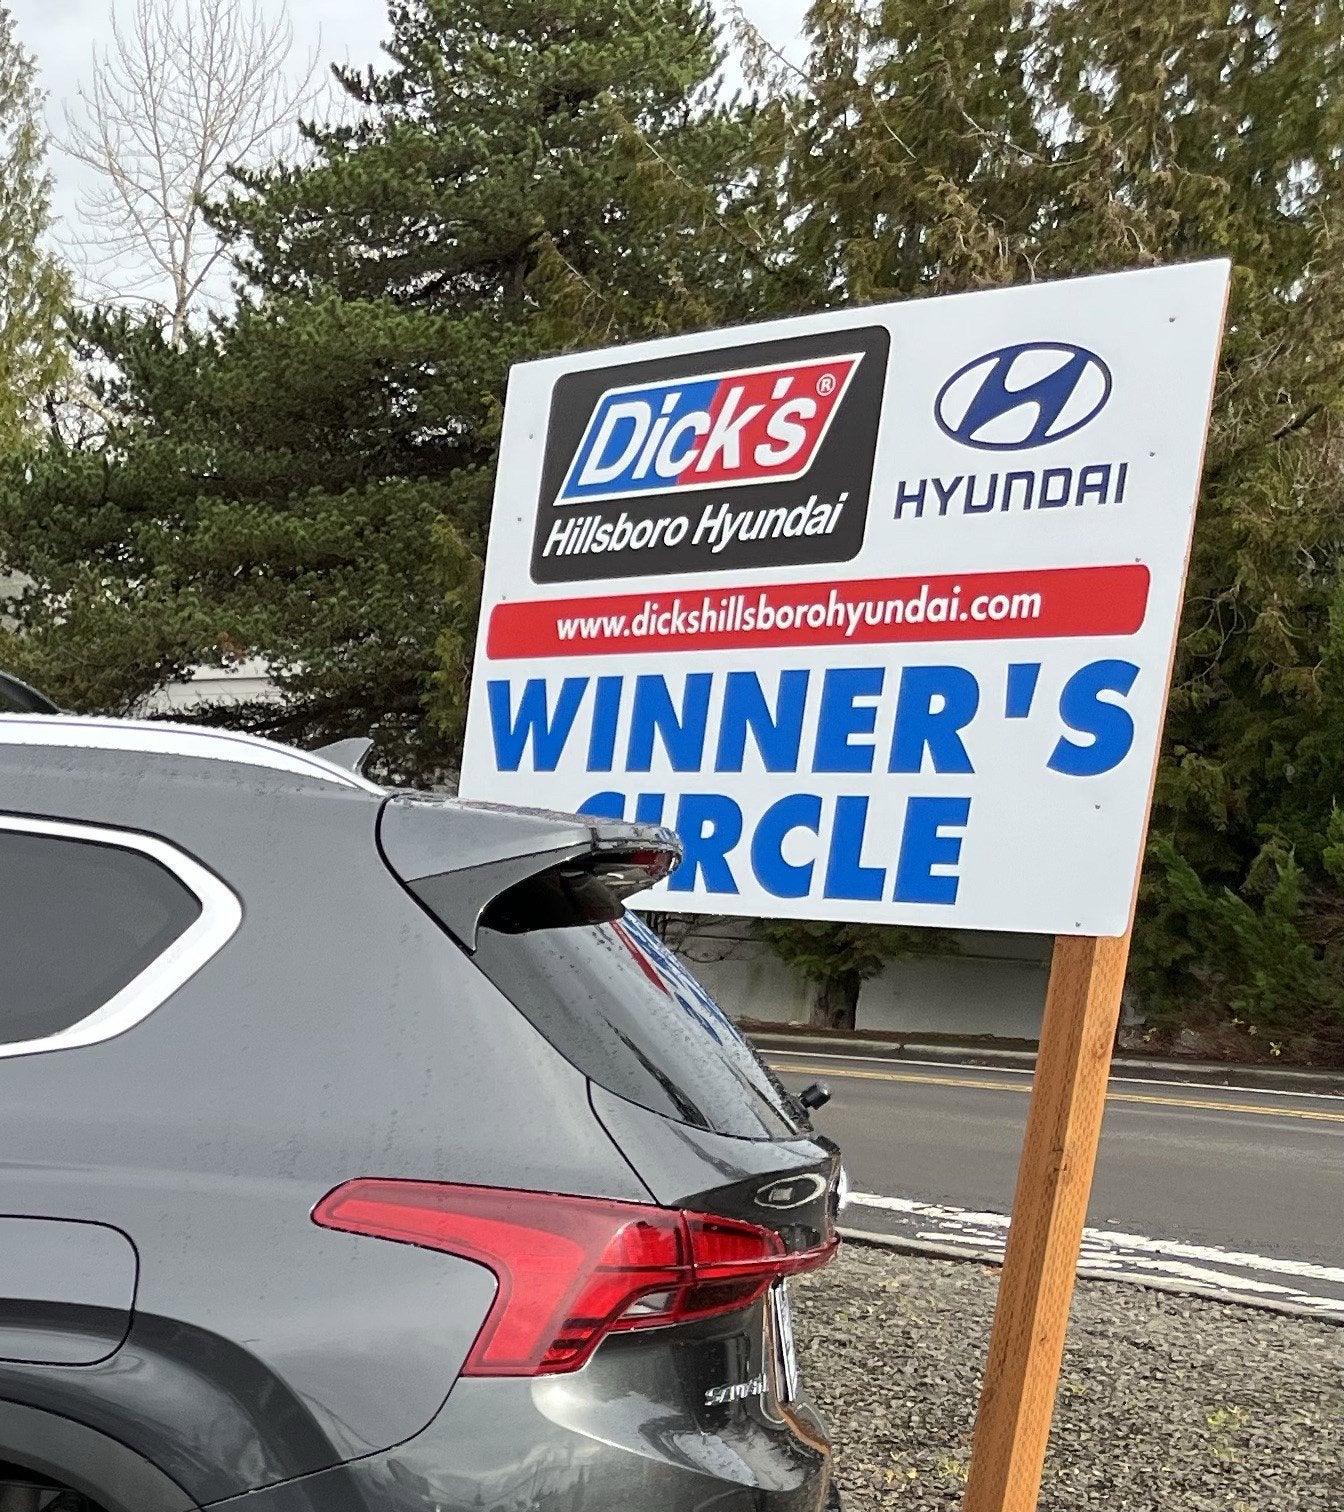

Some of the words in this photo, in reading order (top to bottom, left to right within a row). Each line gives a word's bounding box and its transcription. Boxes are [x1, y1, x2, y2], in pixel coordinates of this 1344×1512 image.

[893, 462, 1129, 520] HYUNDAI
[542, 513, 690, 558] Hillsboro
[693, 492, 850, 554] Hyundai
[556, 586, 1042, 642] www.dickshillsborohyundai.com
[486, 658, 1142, 778] WINNER'S
